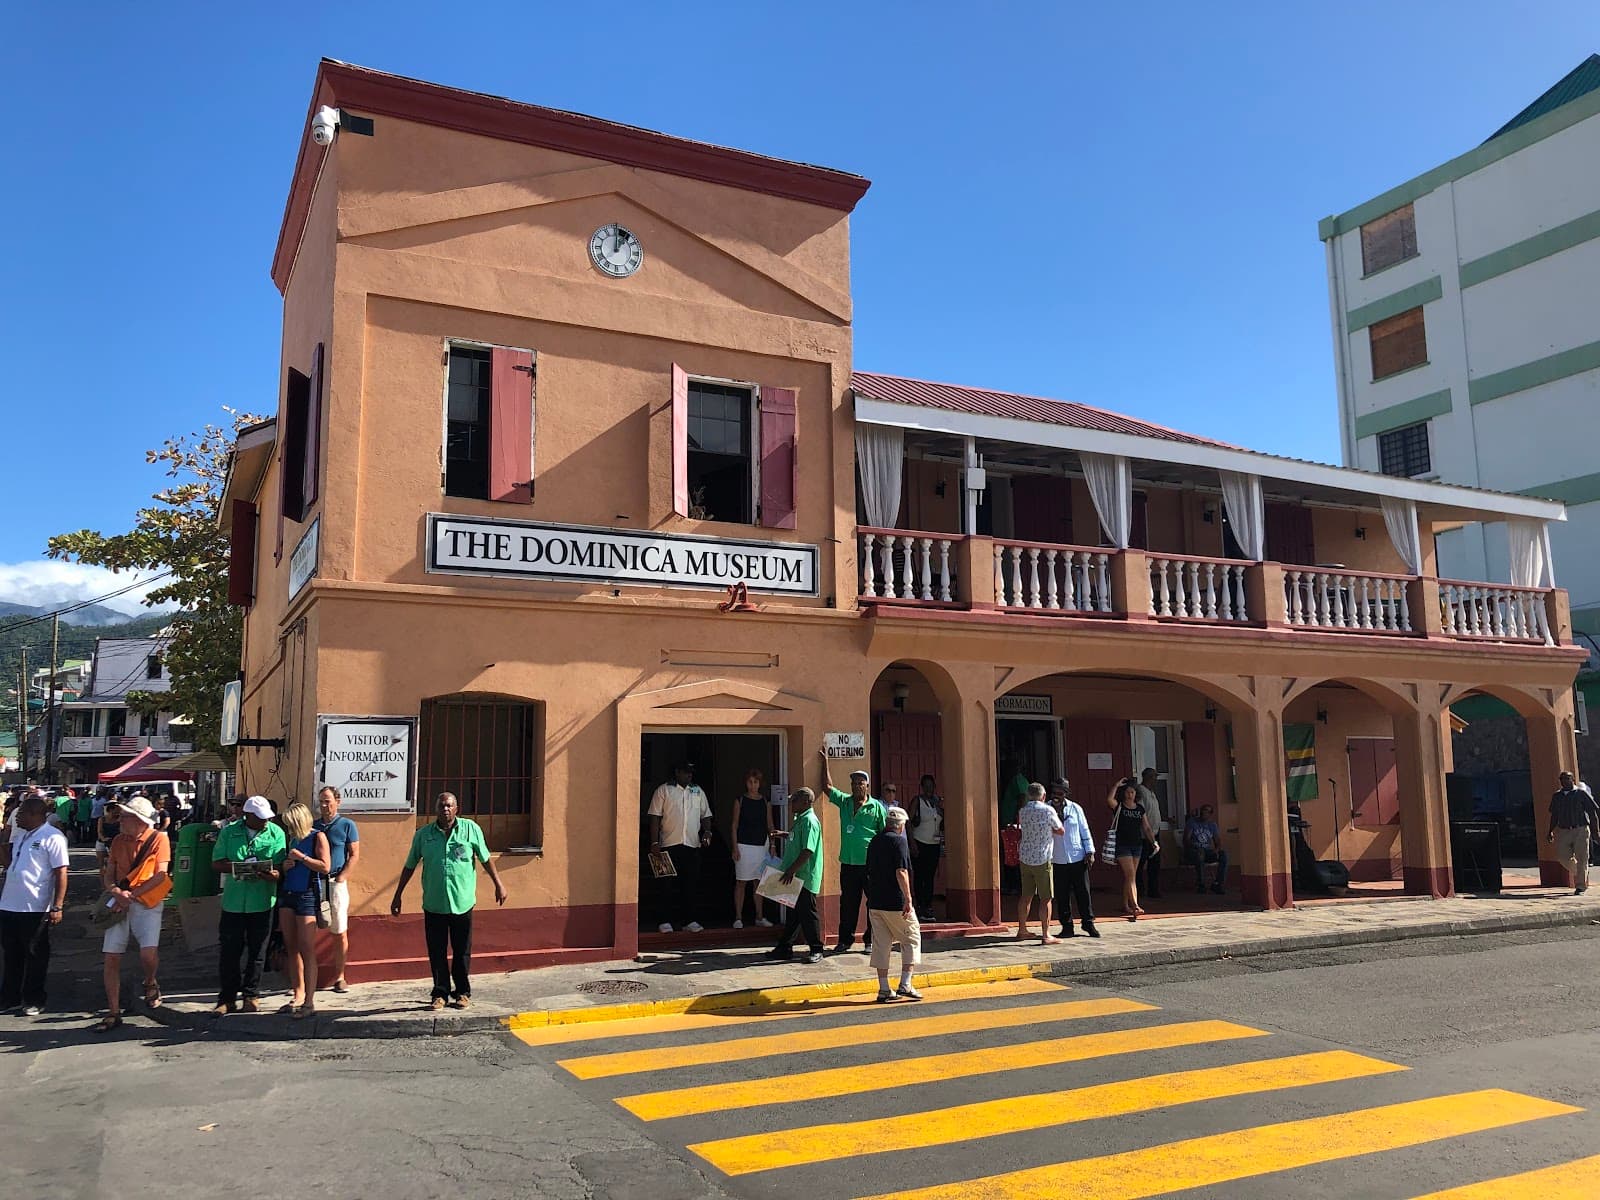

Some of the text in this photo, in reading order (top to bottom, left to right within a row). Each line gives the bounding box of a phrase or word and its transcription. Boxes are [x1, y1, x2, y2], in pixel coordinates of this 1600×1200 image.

[444, 529, 803, 583] THE DOMINICA MUSEUM
[995, 696, 1049, 712] FORMATION
[346, 734, 389, 746] VISITOR
[838, 734, 850, 745] NO
[329, 751, 405, 762] INFORMATION
[827, 746, 864, 757] OITERING
[349, 771, 384, 782] CRAFT
[343, 788, 388, 799] MARKET
